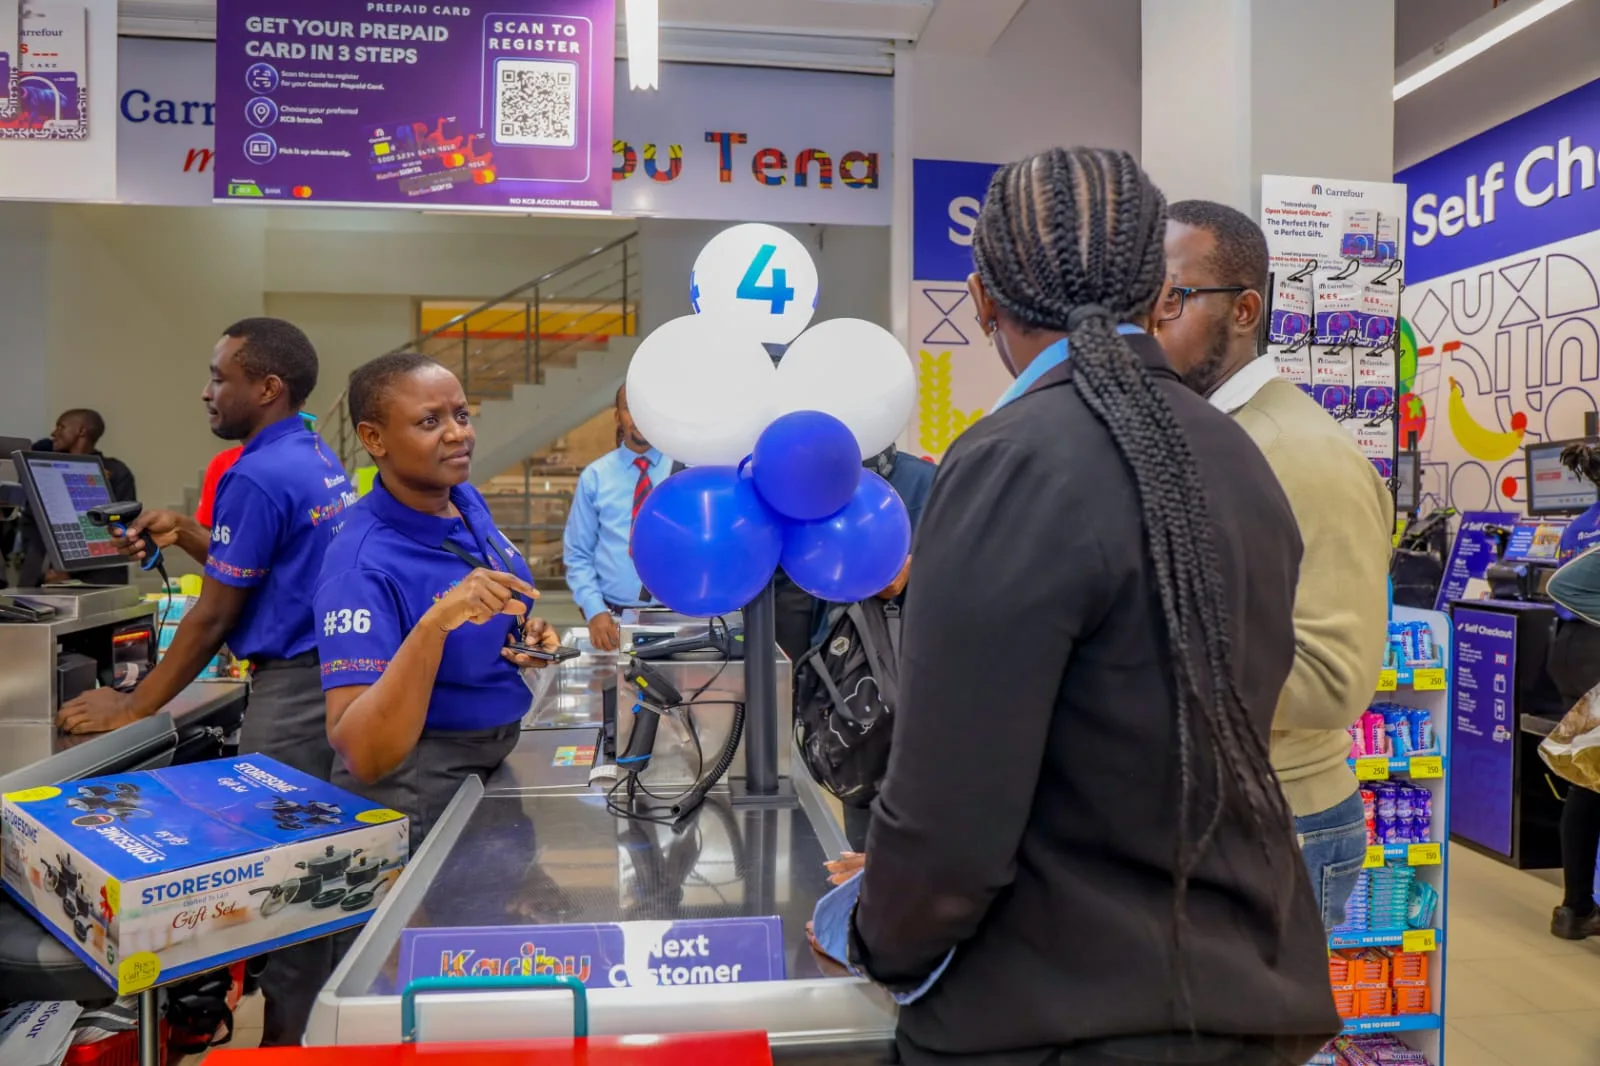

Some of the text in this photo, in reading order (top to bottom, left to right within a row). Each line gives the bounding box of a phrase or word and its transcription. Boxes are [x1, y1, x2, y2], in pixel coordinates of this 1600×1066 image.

[367, 2, 471, 17] PREPAID CARD
[245, 16, 449, 42] GET YOUR PREPAID
[494, 22, 576, 36] SCAN TO
[245, 40, 418, 64] CARD IN 3 STEPS
[489, 38, 580, 54] REGISTER
[280, 105, 307, 113] Choose
[296, 116, 323, 124] branch
[704, 131, 879, 189] Tena
[1326, 188, 1364, 198] Carrefour
[1412, 136, 1600, 246] Self Ch
[1309, 220, 1317, 228] Fit
[736, 244, 794, 314] 4
[1320, 293, 1338, 301] KES
[323, 608, 371, 637] #36
[1464, 623, 1512, 639] Self Checkout
[234, 762, 298, 792] STORESOME
[142, 862, 264, 904] STORESOME
[173, 900, 236, 929] Gift Set
[440, 941, 591, 982] Karibu
